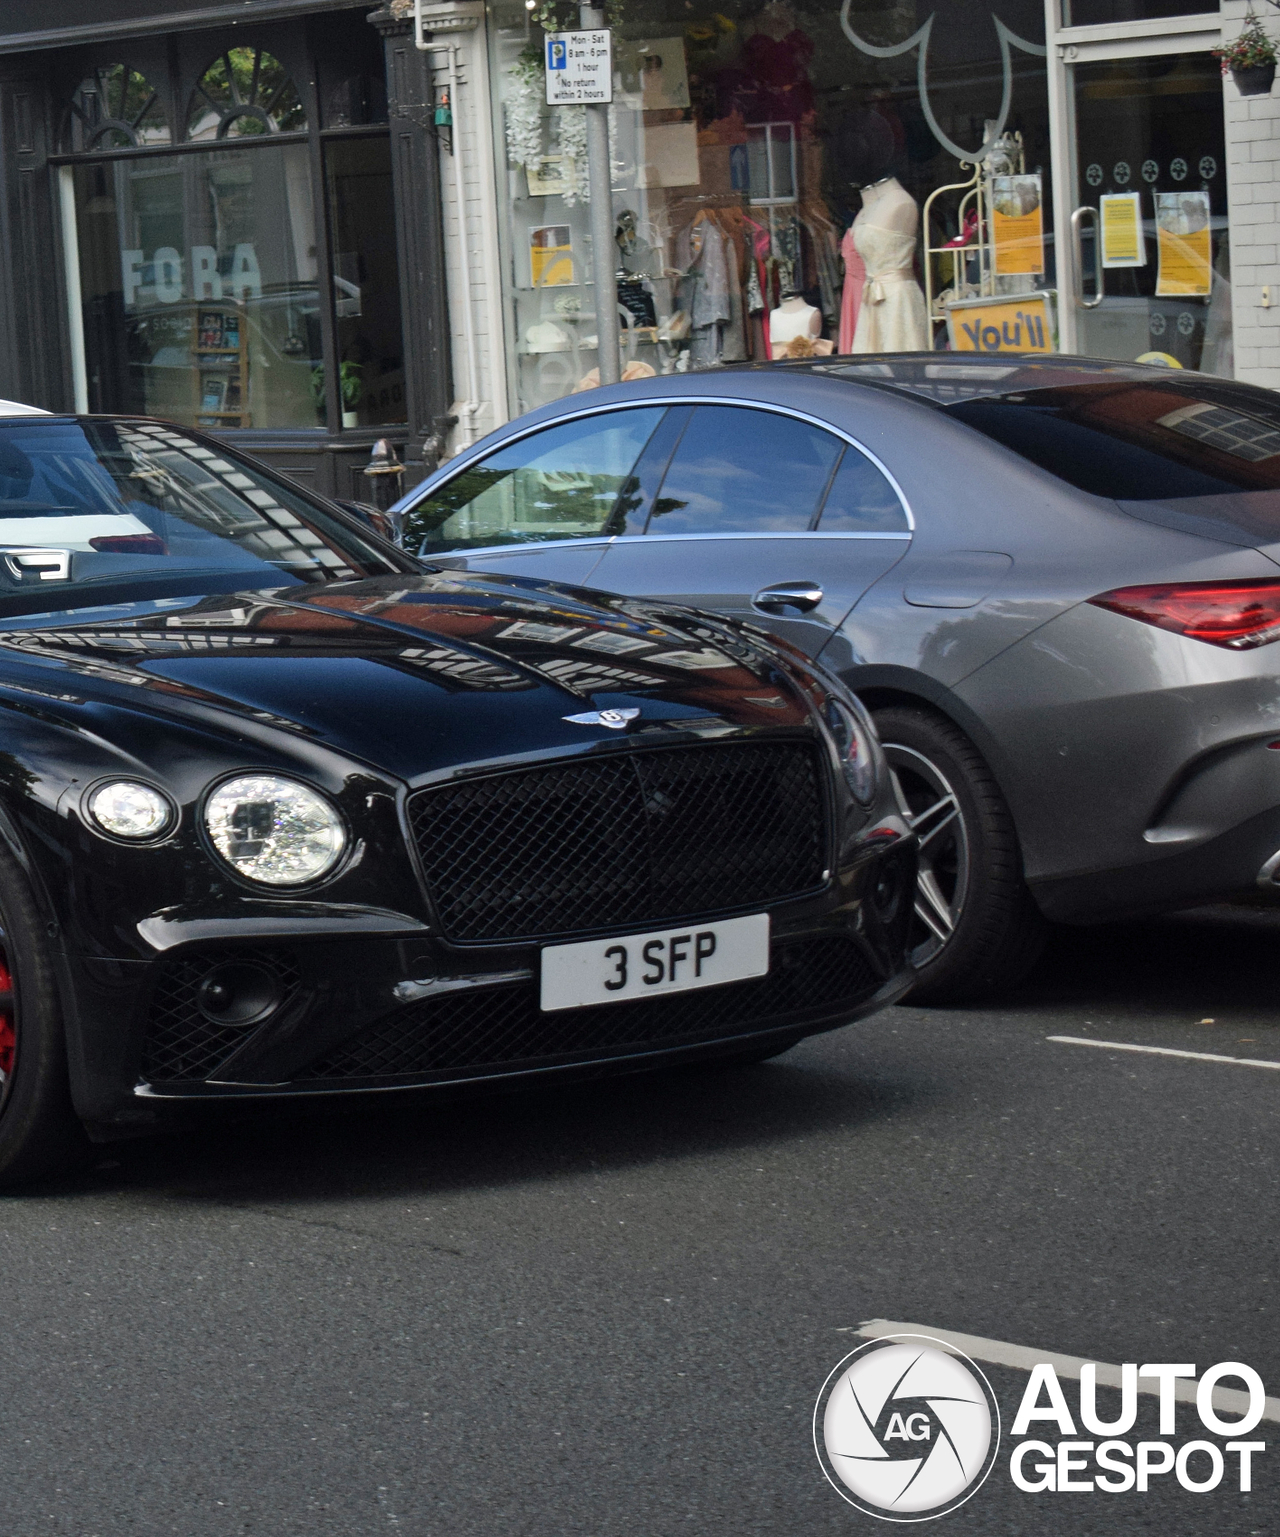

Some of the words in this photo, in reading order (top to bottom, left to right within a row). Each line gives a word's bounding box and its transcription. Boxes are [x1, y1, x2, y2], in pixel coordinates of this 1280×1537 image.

[571, 35, 586, 44] Mon
[592, 34, 605, 43] Sat
[569, 49, 573, 58] 8
[591, 47, 595, 57] 6
[596, 50, 608, 58] pm
[583, 63, 599, 71] hour
[561, 79, 571, 87] No
[573, 79, 596, 87] return
[554, 90, 575, 99] within
[577, 89, 582, 98] 2
[584, 90, 604, 98] hours
[121, 243, 262, 304] FORA
[961, 311, 1045, 351] You'll
[604, 945, 628, 991] 3
[641, 931, 716, 985] SFP
